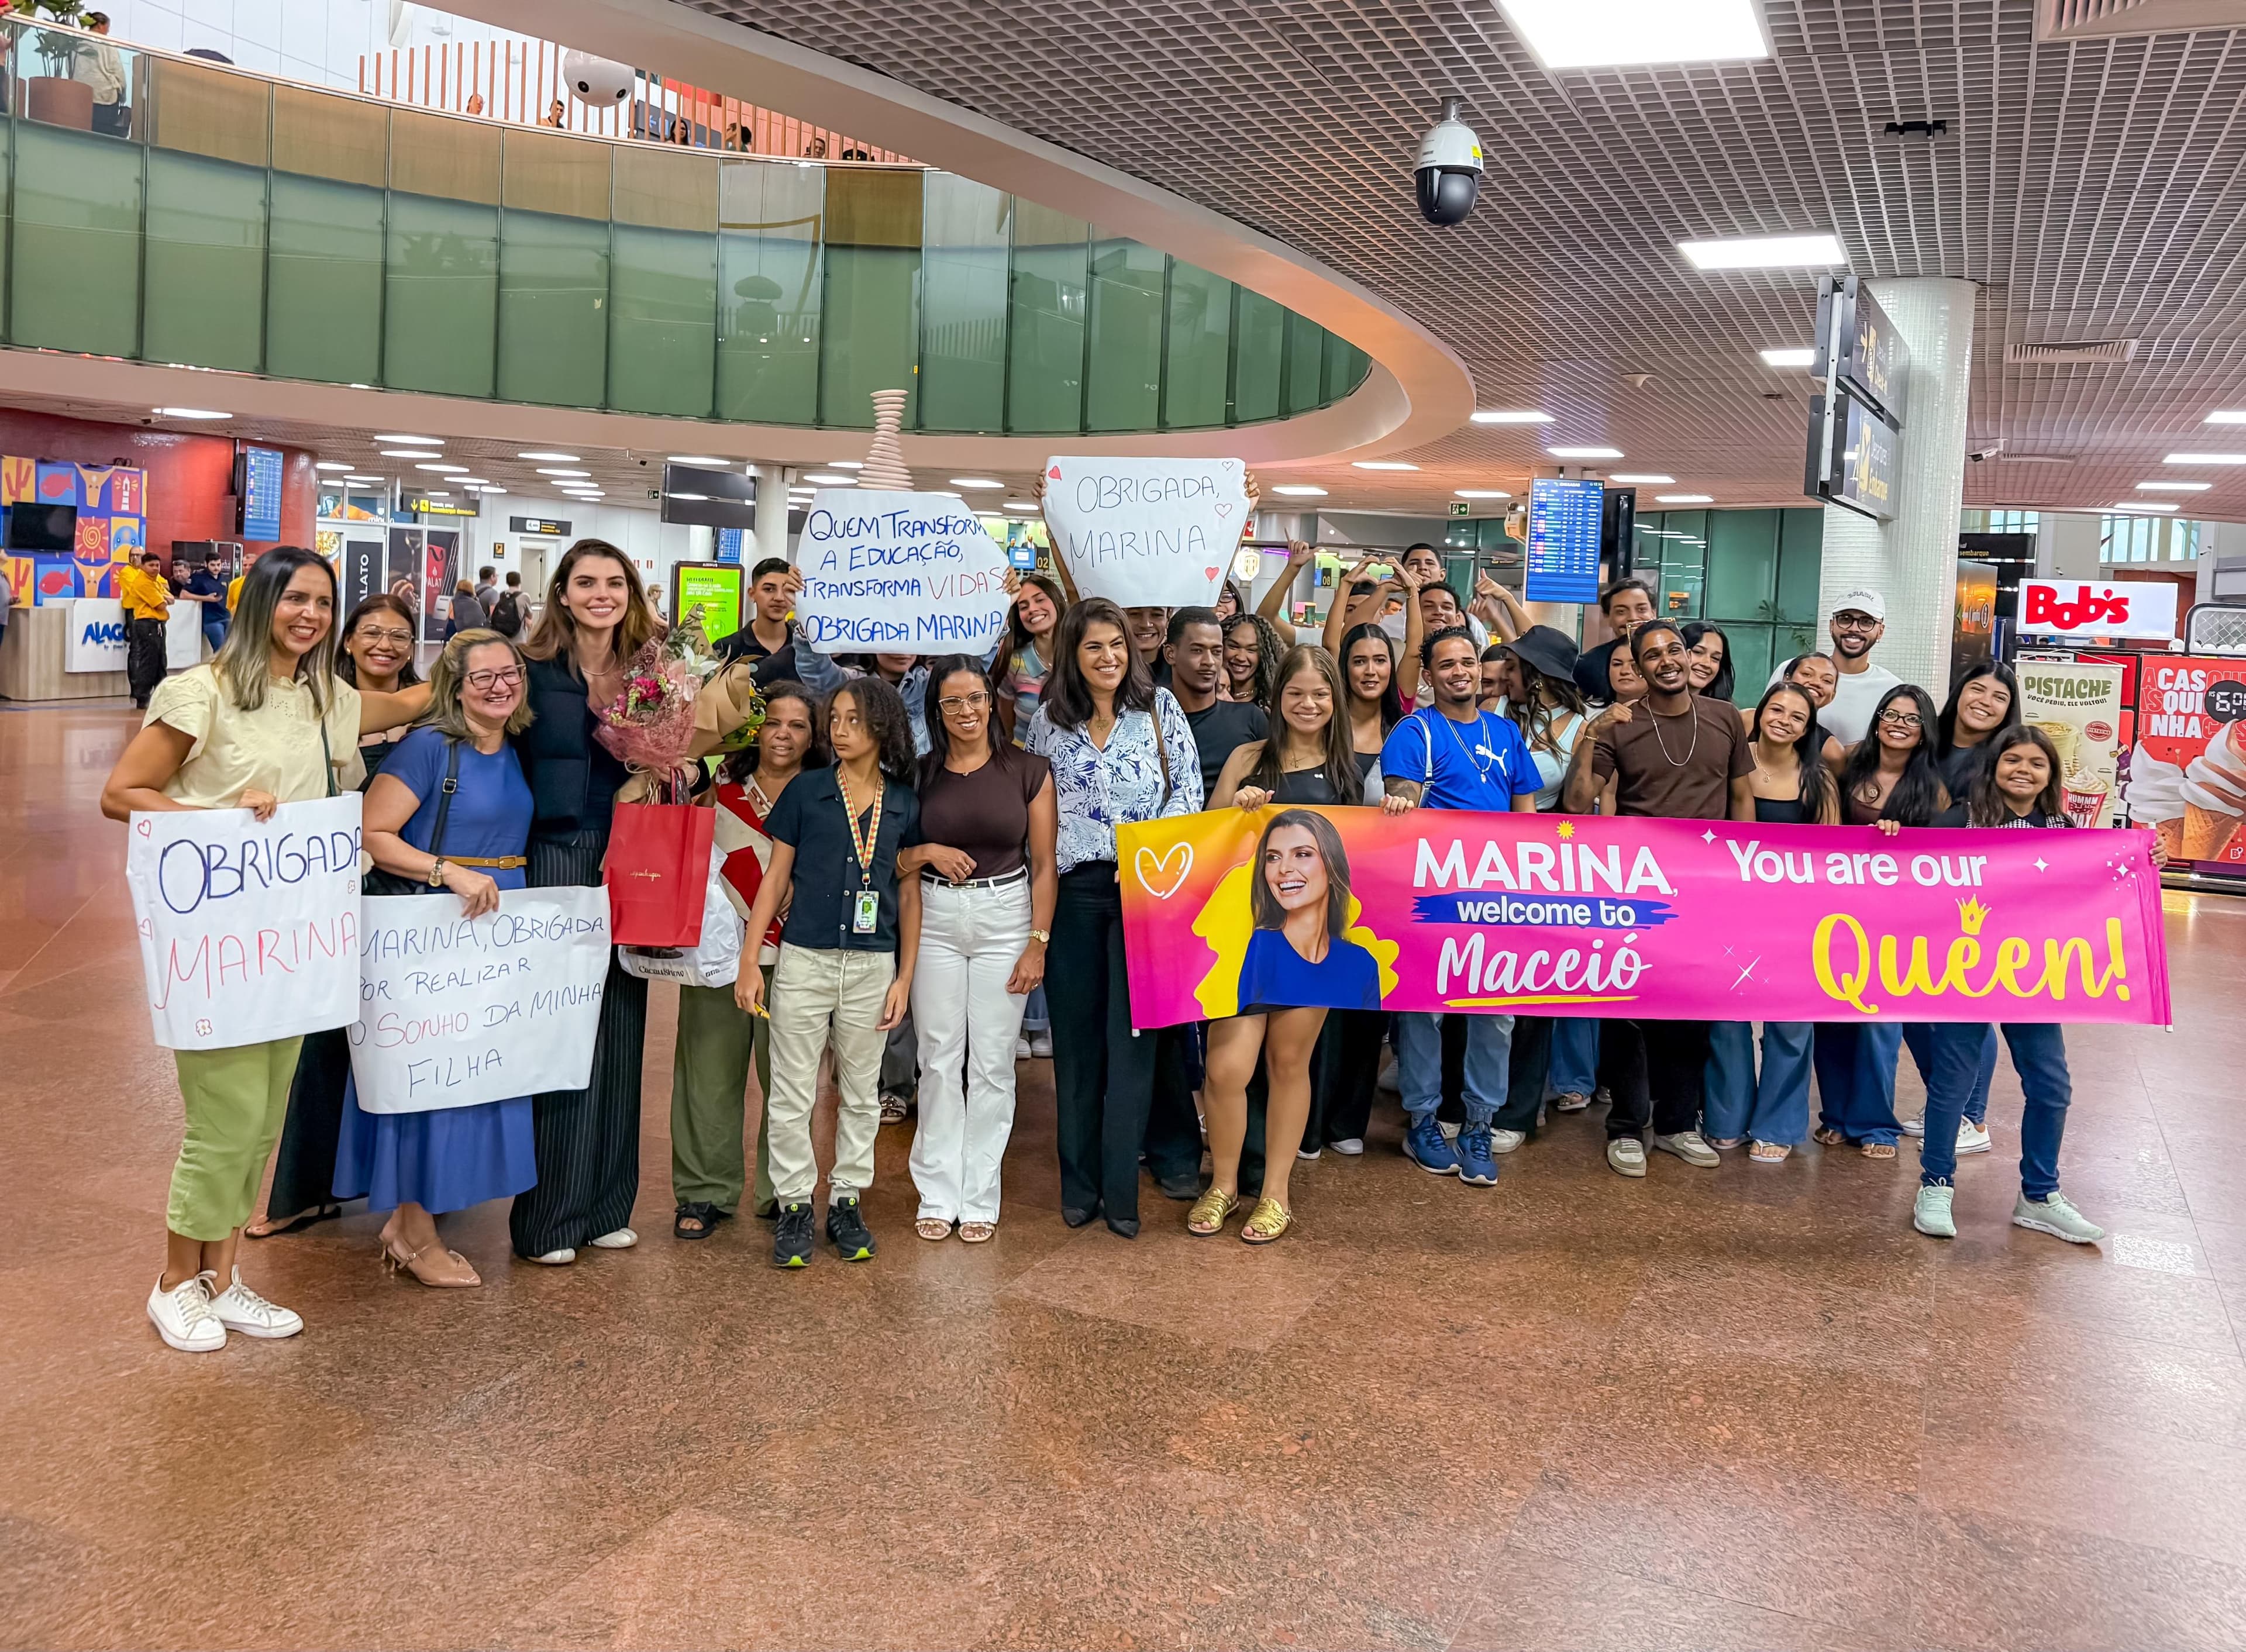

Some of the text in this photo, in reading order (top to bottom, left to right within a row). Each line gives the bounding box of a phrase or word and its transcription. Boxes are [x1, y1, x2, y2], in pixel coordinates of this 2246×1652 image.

[1077, 476, 1219, 513] OBRIGADA,
[809, 510, 880, 540] QUEM
[820, 540, 963, 571] A EDUCAÇÃO,
[1037, 557, 1049, 568] 02
[1070, 525, 1205, 575] MARINA
[803, 567, 1005, 600] TRANSFORMA VIDAS
[1322, 576, 1331, 586] 08
[2025, 585, 2129, 630] Bob's
[805, 611, 1003, 643] OBRIGADA MARINA
[2024, 677, 2113, 699] PISTACHE
[2027, 694, 2044, 703] VOCÊ
[2045, 698, 2066, 706] PEDIU,
[2080, 698, 2107, 706] VOLTOU!
[159, 826, 361, 913] OBRIGADA
[1413, 837, 1679, 897] MARINA,
[1725, 840, 1987, 887] You are our
[1457, 895, 1636, 926] welcome to
[492, 914, 604, 947] OBRIGADA
[154, 911, 357, 1010] MARINA
[404, 957, 532, 995] REALIZAR
[1437, 932, 1654, 995] Maceió
[1812, 912, 2131, 1014] Queen!
[374, 1012, 469, 1048] SONHO
[483, 1001, 522, 1028] DA
[530, 982, 602, 1019] MINHA
[408, 1049, 503, 1098] FILHA
